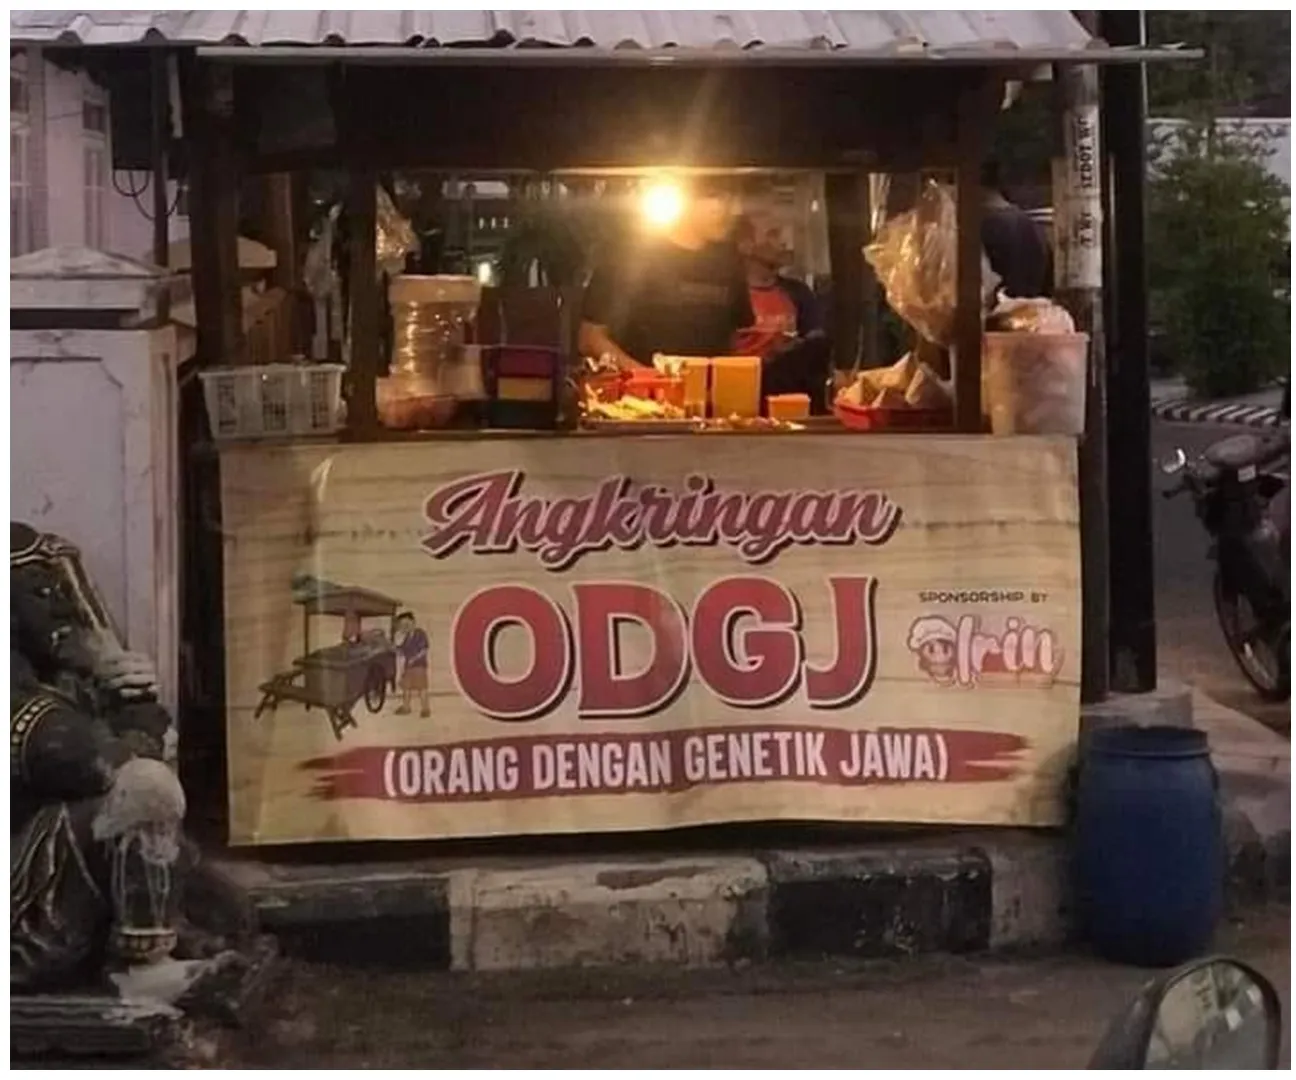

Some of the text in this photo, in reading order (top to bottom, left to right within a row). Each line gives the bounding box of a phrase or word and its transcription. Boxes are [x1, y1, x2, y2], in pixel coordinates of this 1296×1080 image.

[420, 468, 902, 572] Angkringan
[918, 590, 1049, 604] SPONSORSHIP BY
[452, 573, 877, 721] ODGJ
[383, 730, 950, 798] (ORANG DENGAN GENETIK JAWA)
